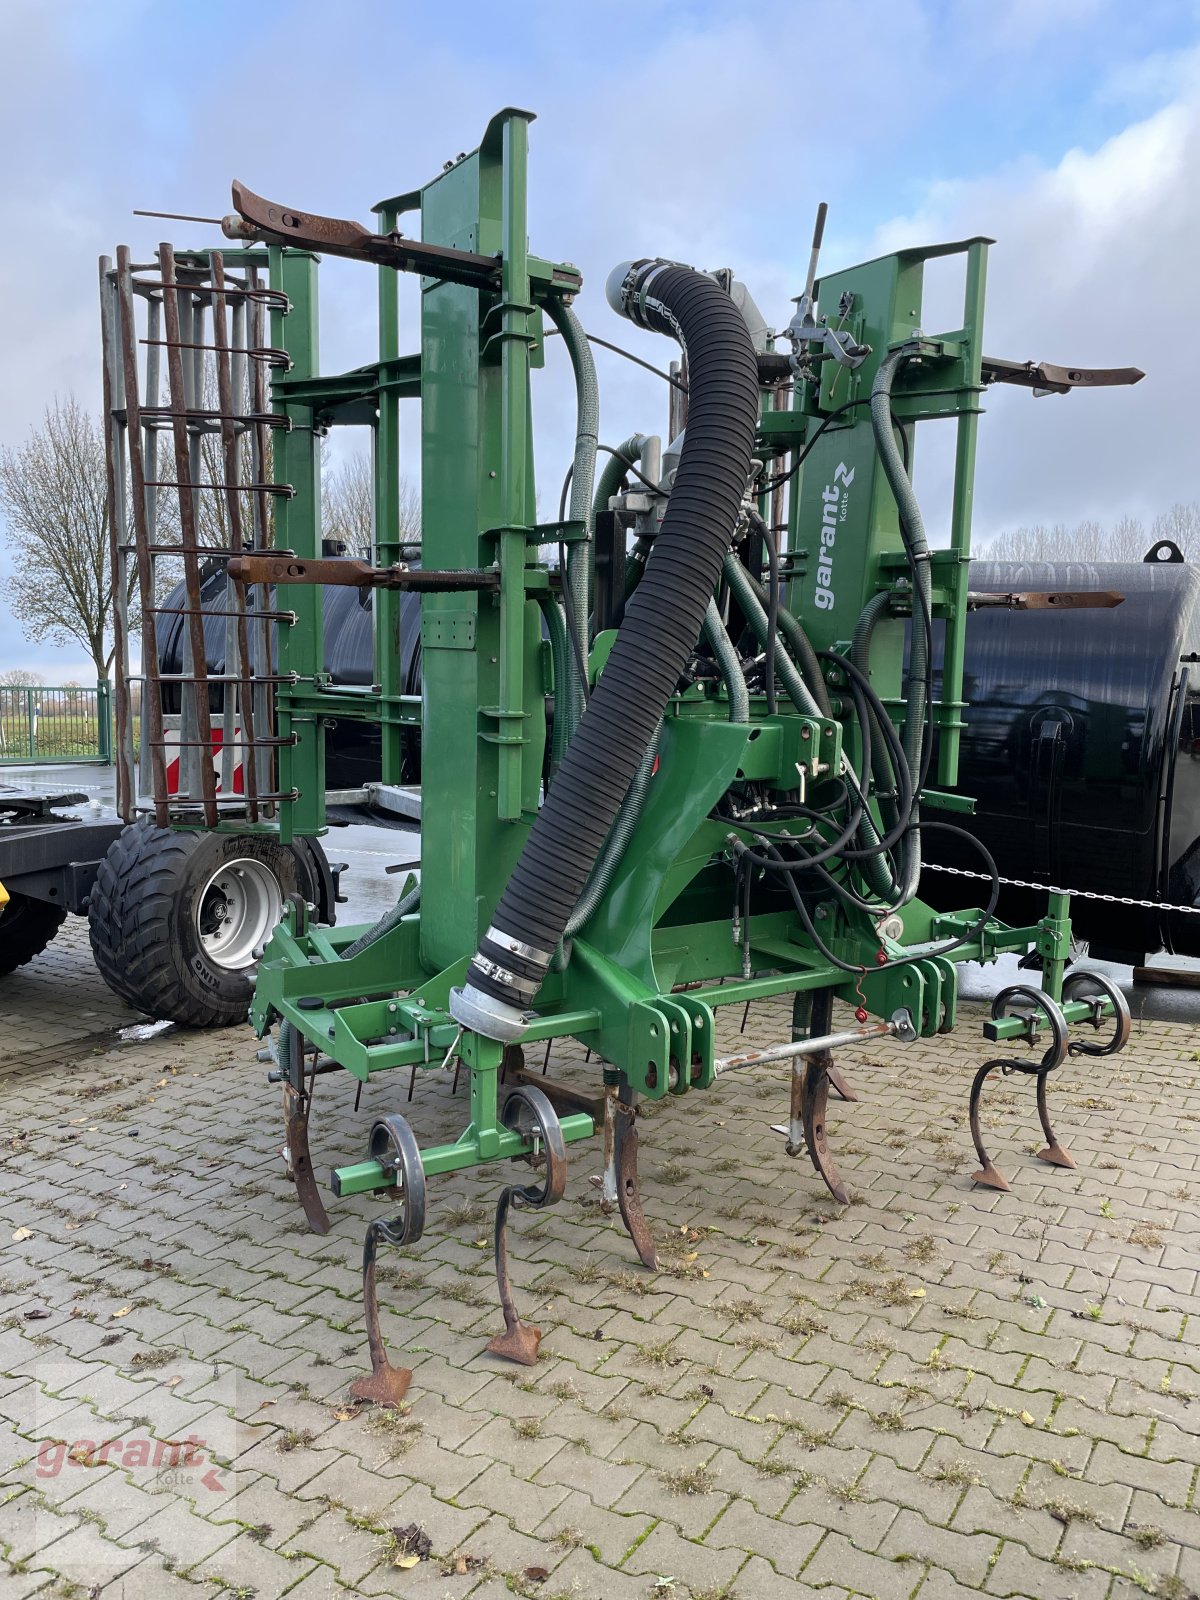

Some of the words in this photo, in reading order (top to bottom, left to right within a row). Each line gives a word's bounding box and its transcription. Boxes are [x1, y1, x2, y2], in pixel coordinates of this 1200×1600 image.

[839, 492, 849, 522] Kotte
[814, 485, 840, 610] garant
[195, 959, 221, 990] KING
